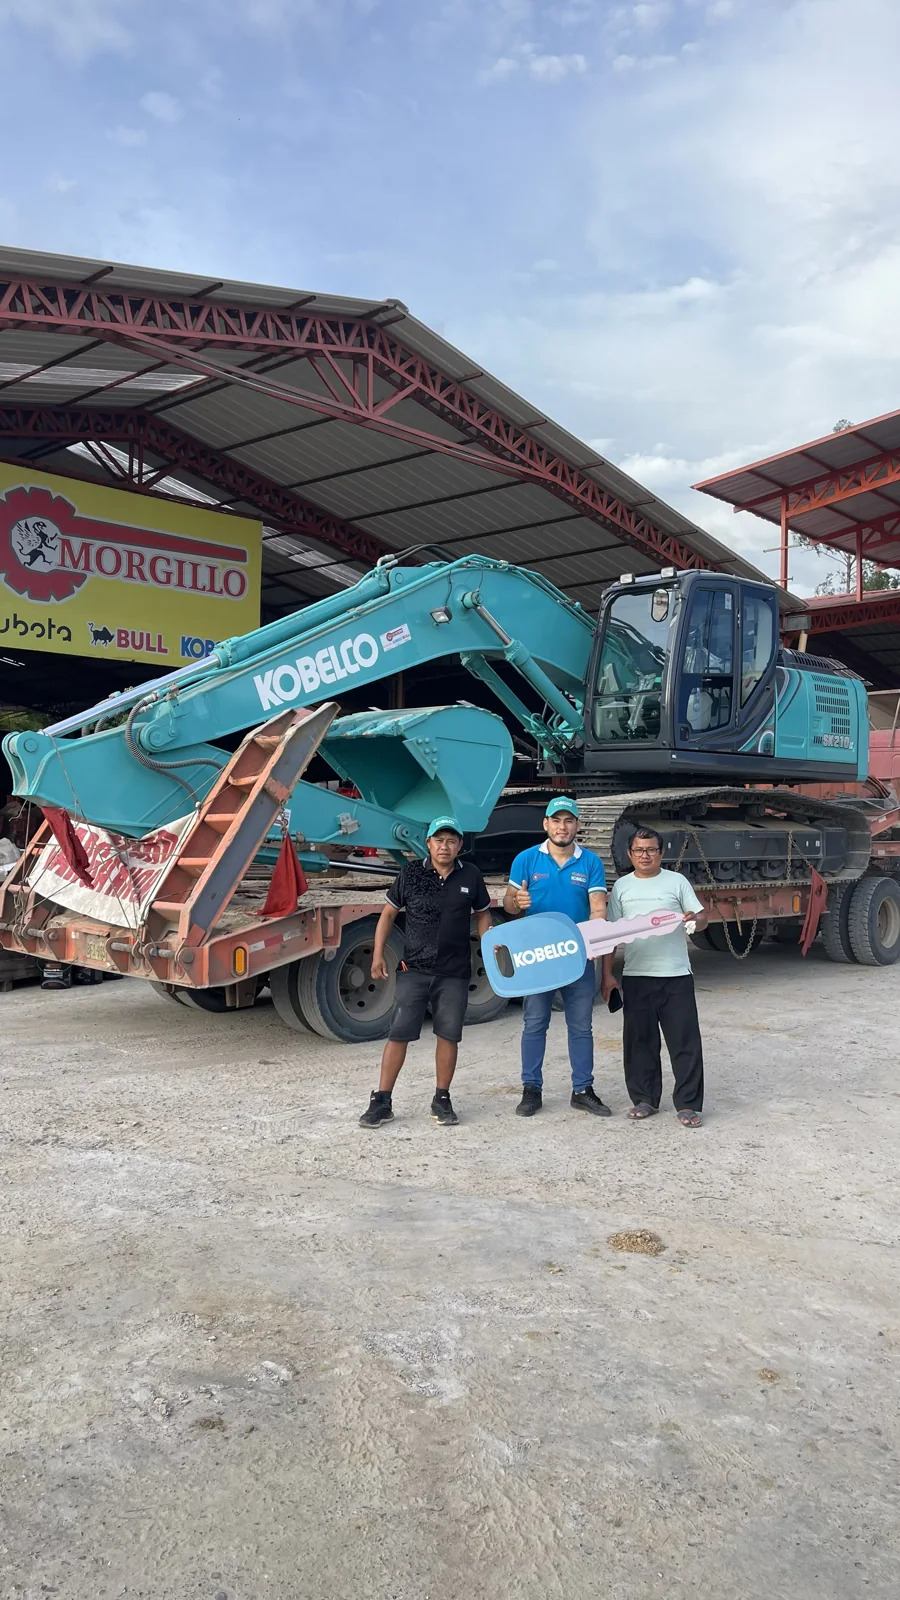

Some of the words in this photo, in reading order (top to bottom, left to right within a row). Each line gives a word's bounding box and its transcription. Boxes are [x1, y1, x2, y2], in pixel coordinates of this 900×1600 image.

[57, 537, 246, 597] MORGILLO
[116, 628, 168, 654] BULL
[181, 635, 221, 659] KOB
[253, 633, 379, 711] KOBELCO
[513, 940, 578, 968] KOBELCO
